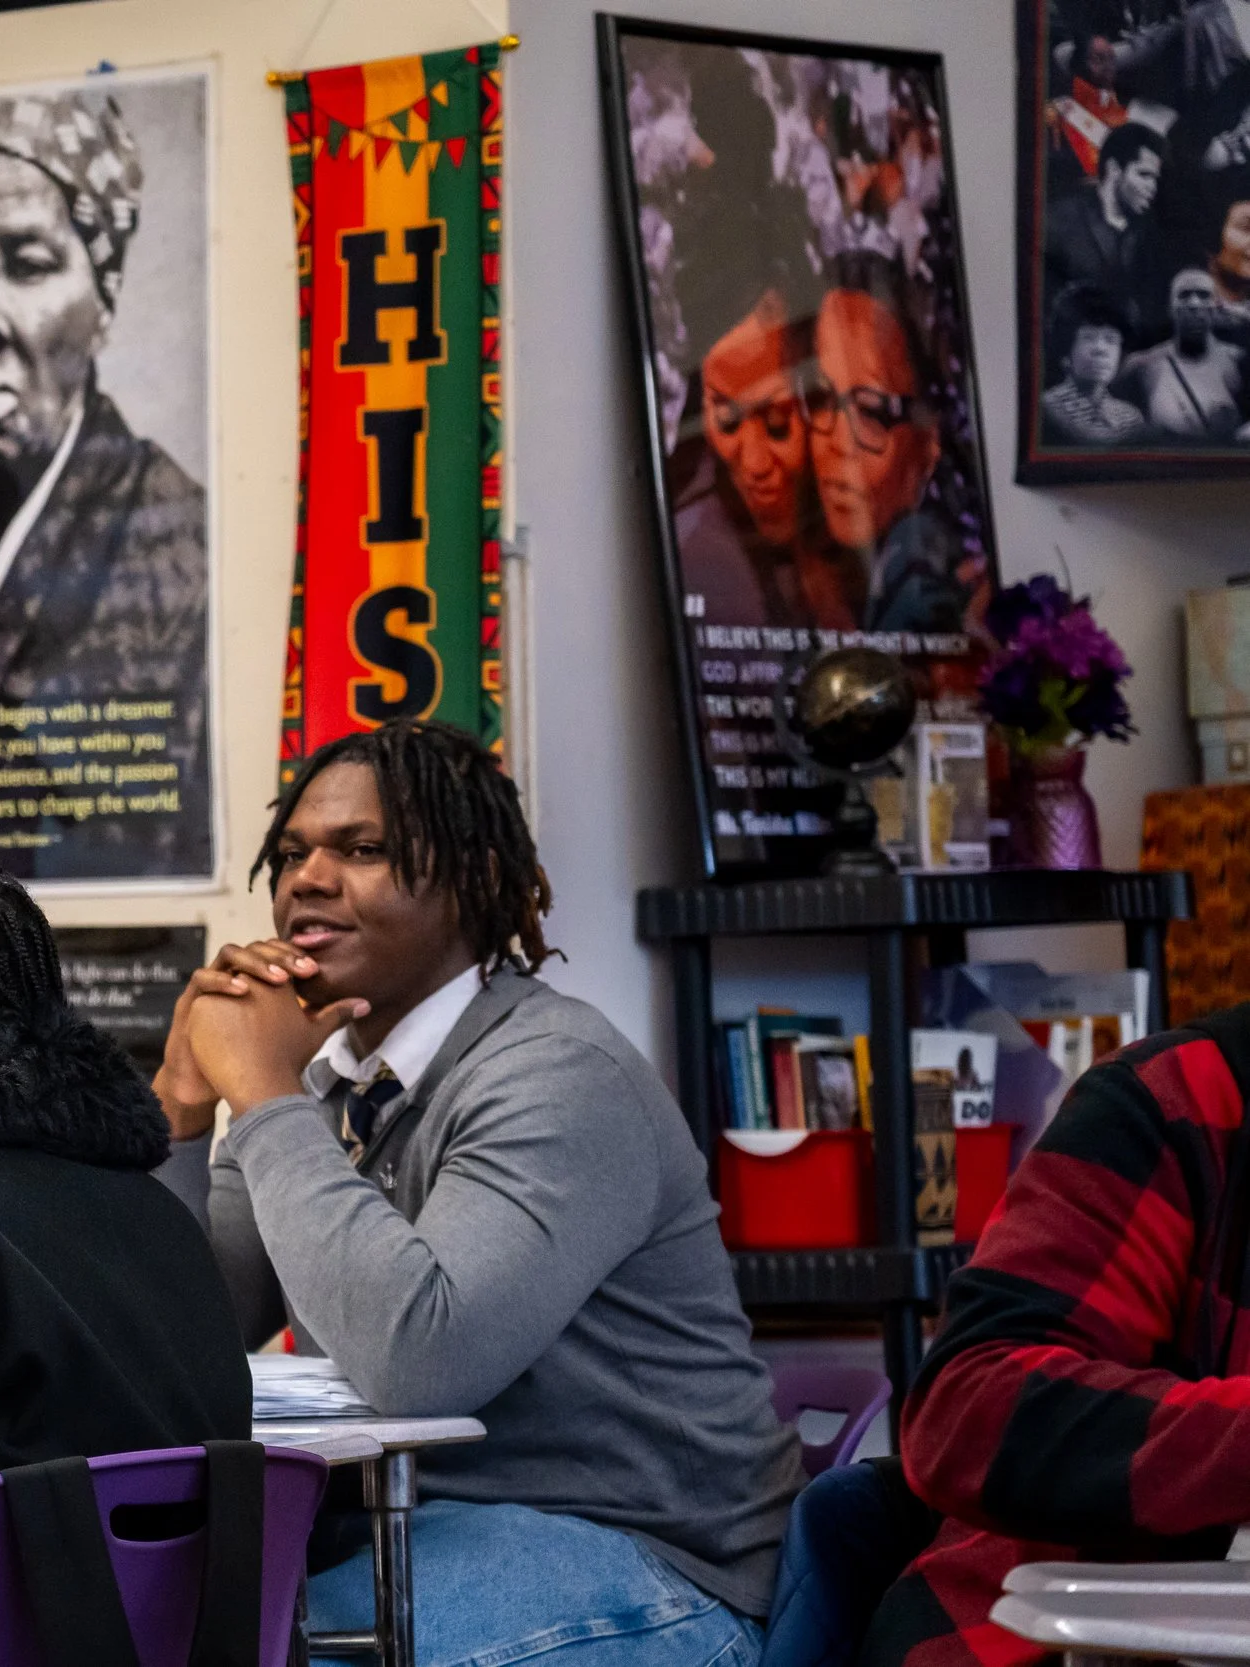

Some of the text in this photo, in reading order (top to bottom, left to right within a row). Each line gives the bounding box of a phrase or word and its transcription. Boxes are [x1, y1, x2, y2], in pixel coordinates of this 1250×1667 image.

[339, 224, 444, 722] HIS
[50, 701, 88, 723] with
[89, 704, 101, 722] a
[5, 738, 37, 763] you
[38, 731, 77, 755] have
[79, 730, 132, 752] within
[132, 732, 167, 758] you
[52, 761, 83, 785] and
[84, 761, 114, 785] the
[115, 763, 179, 789] passion
[17, 799, 39, 818] to
[39, 793, 96, 822] change
[96, 791, 127, 815] the
